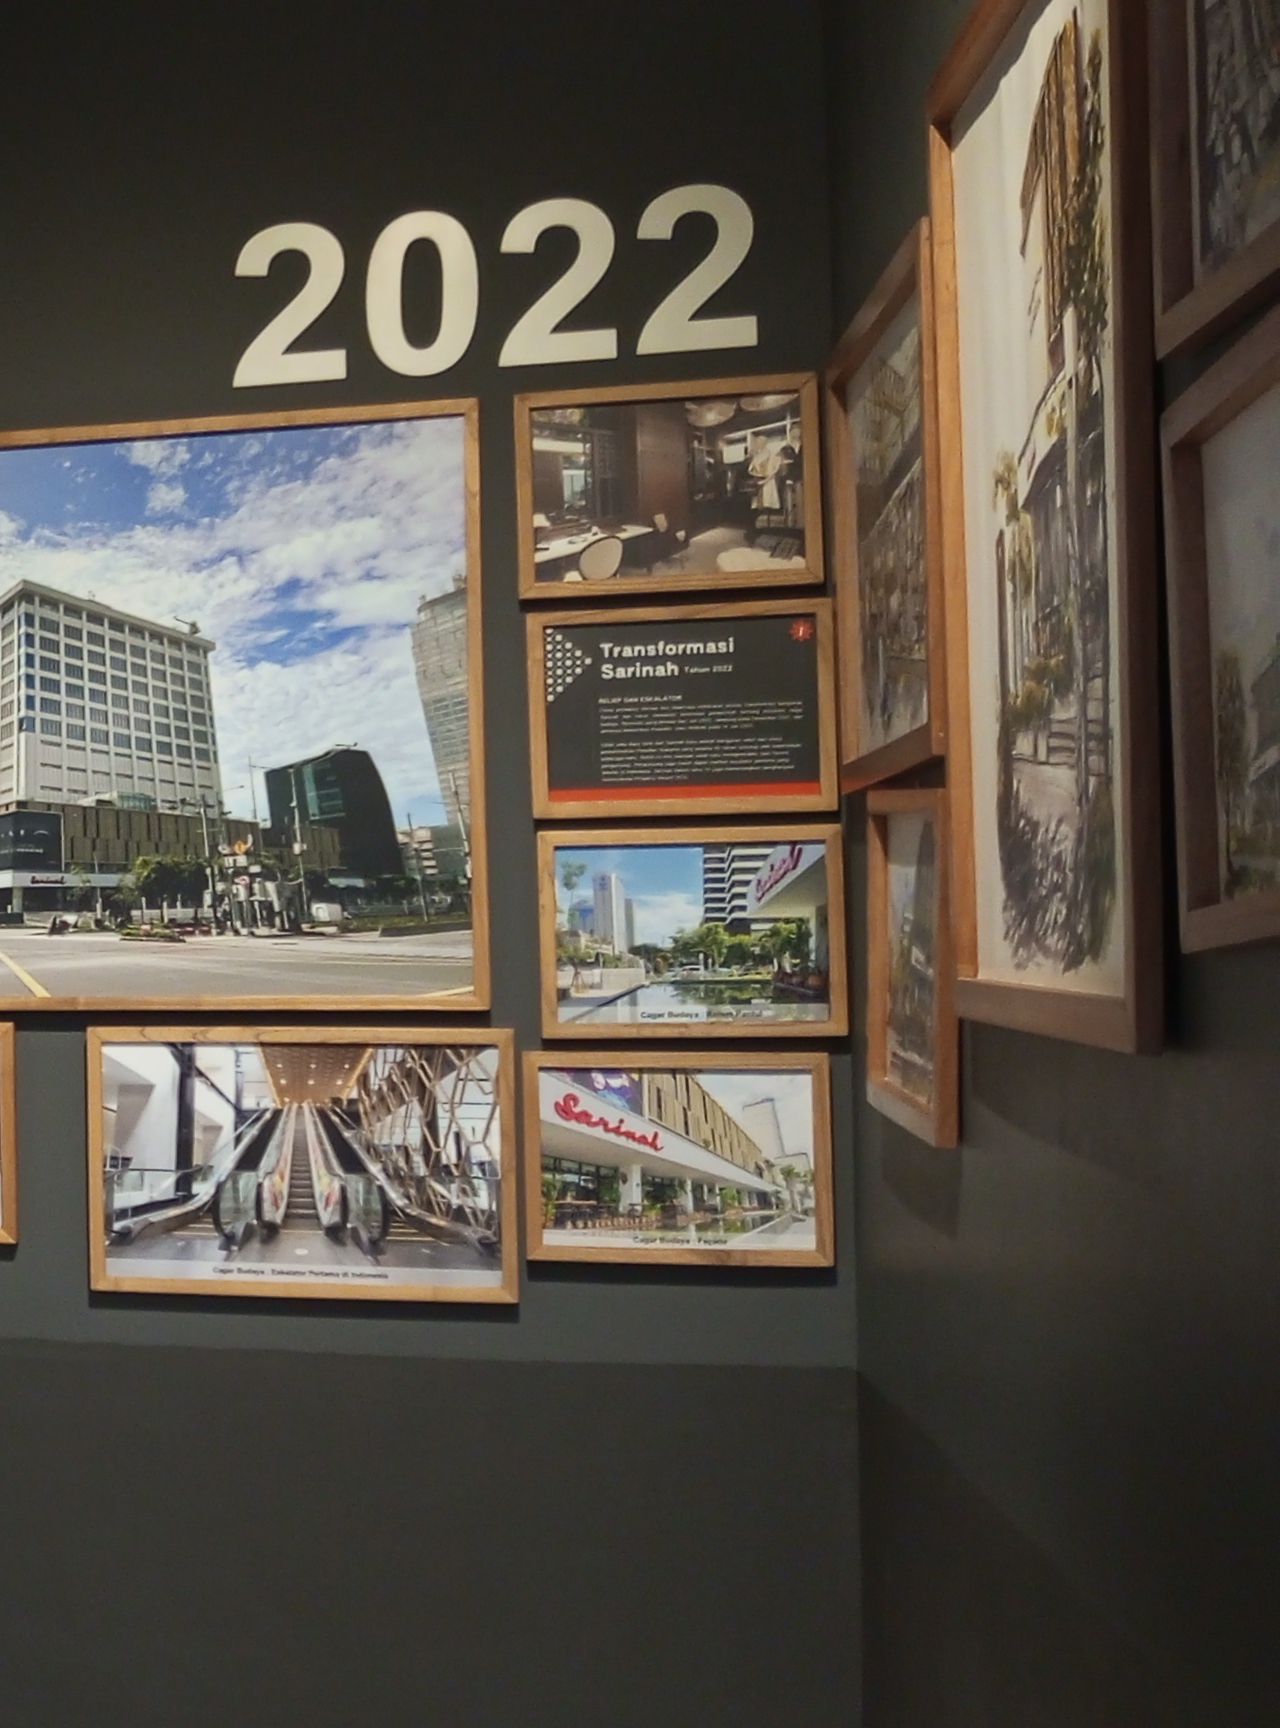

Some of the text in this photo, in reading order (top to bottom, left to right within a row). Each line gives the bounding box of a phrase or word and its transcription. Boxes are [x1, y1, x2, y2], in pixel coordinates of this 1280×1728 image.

[232, 183, 758, 388] 2022
[600, 637, 735, 658] Transformasi
[601, 661, 679, 679] Sarinah
[554, 1093, 664, 1151] Sarinah
